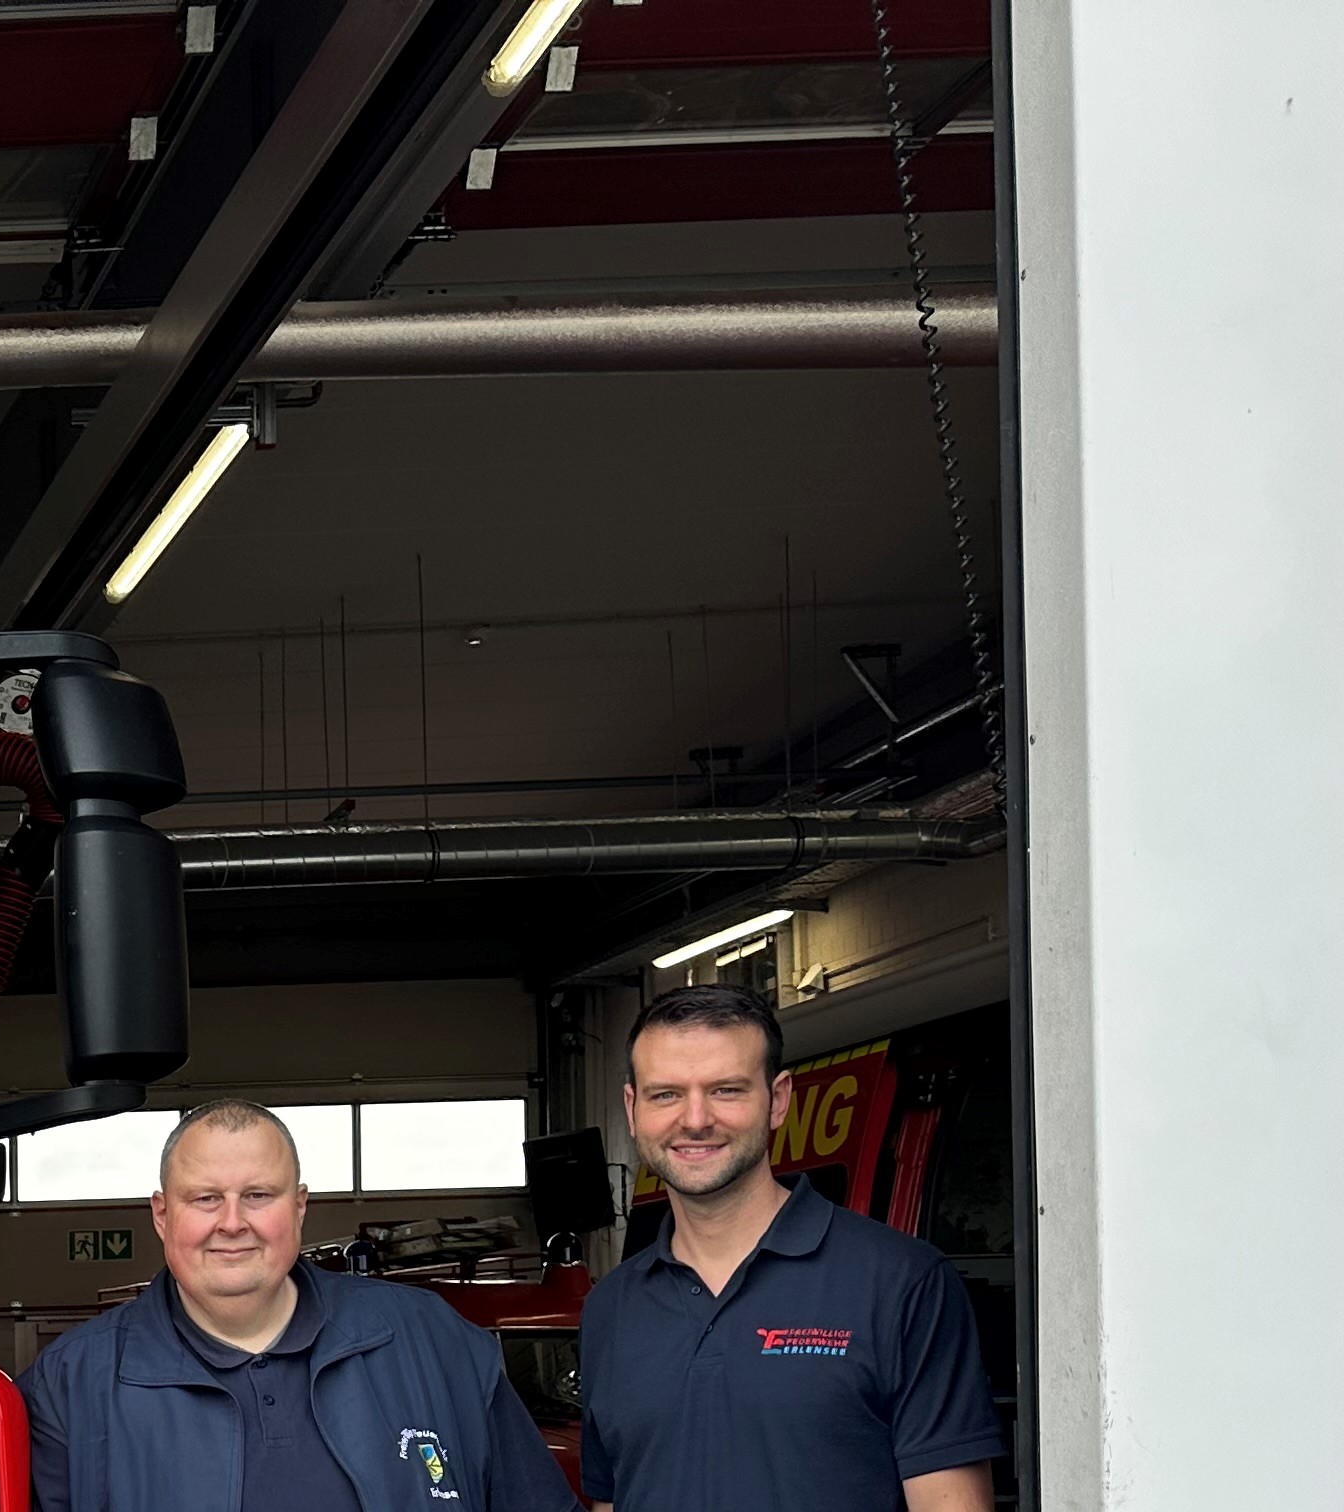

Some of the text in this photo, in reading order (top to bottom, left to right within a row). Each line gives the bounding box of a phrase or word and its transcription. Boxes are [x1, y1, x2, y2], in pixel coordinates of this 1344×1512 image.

[770, 1075, 859, 1166] NG
[785, 1337, 849, 1348] FEUERWEHR
[783, 1346, 847, 1356] ERLENSEE
